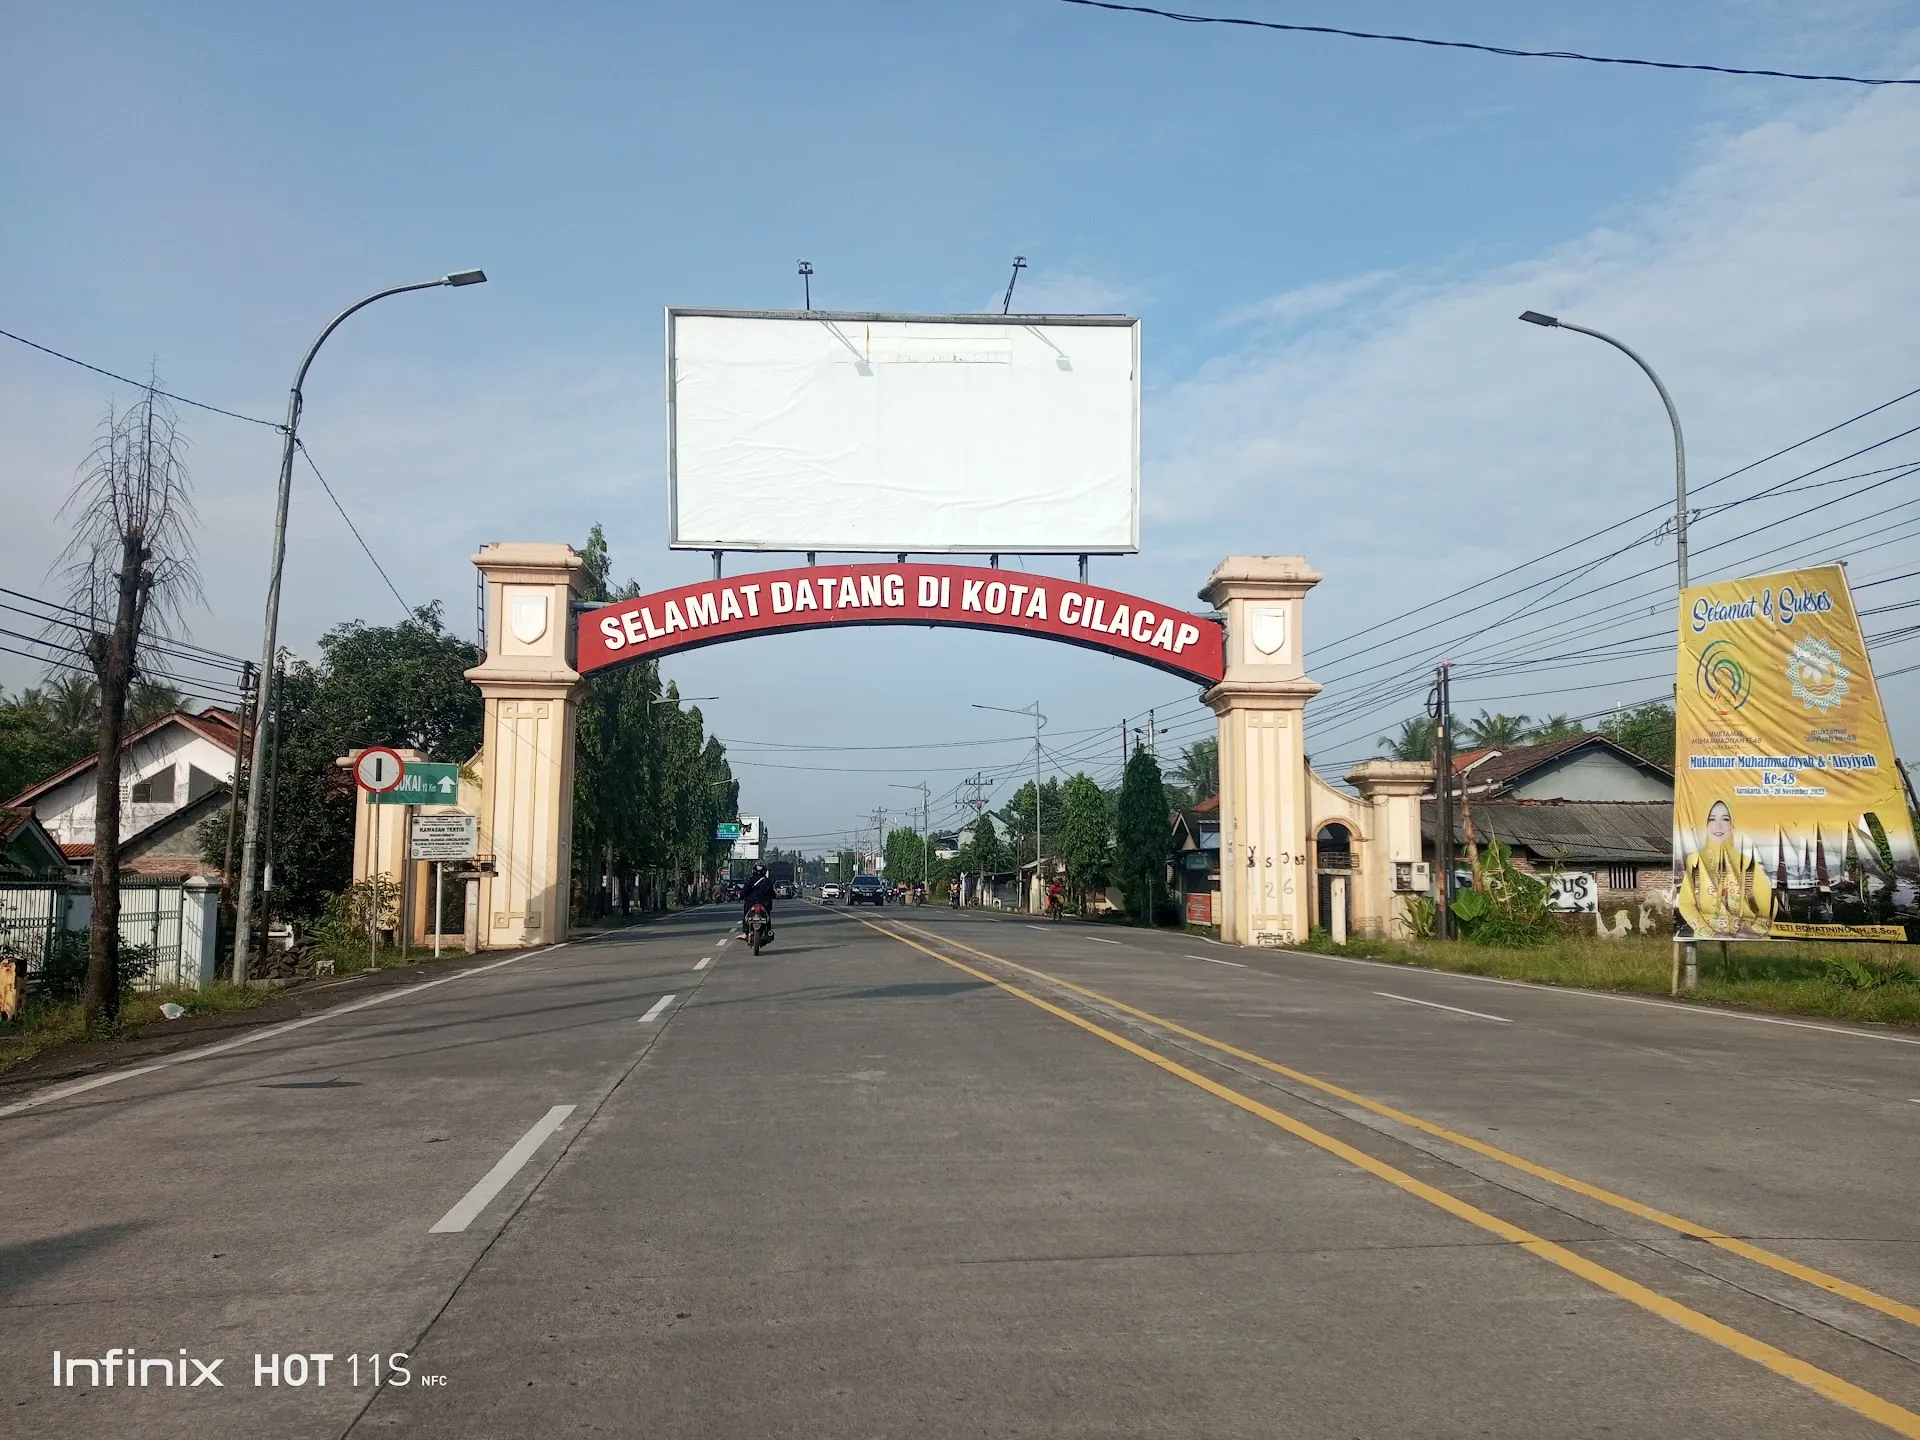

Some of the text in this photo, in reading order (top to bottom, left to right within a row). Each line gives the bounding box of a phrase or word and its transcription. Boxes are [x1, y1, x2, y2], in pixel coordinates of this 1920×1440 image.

[599, 573, 1200, 654] SELAMAT DATANG DI KOTA CILACAP
[1692, 587, 1832, 632] Selamat & Sukses
[1689, 755, 1736, 768] Muktamar
[1737, 755, 1816, 769] Muhammadiyah
[1817, 757, 1826, 768] &
[1763, 772, 1795, 785] Ke-48
